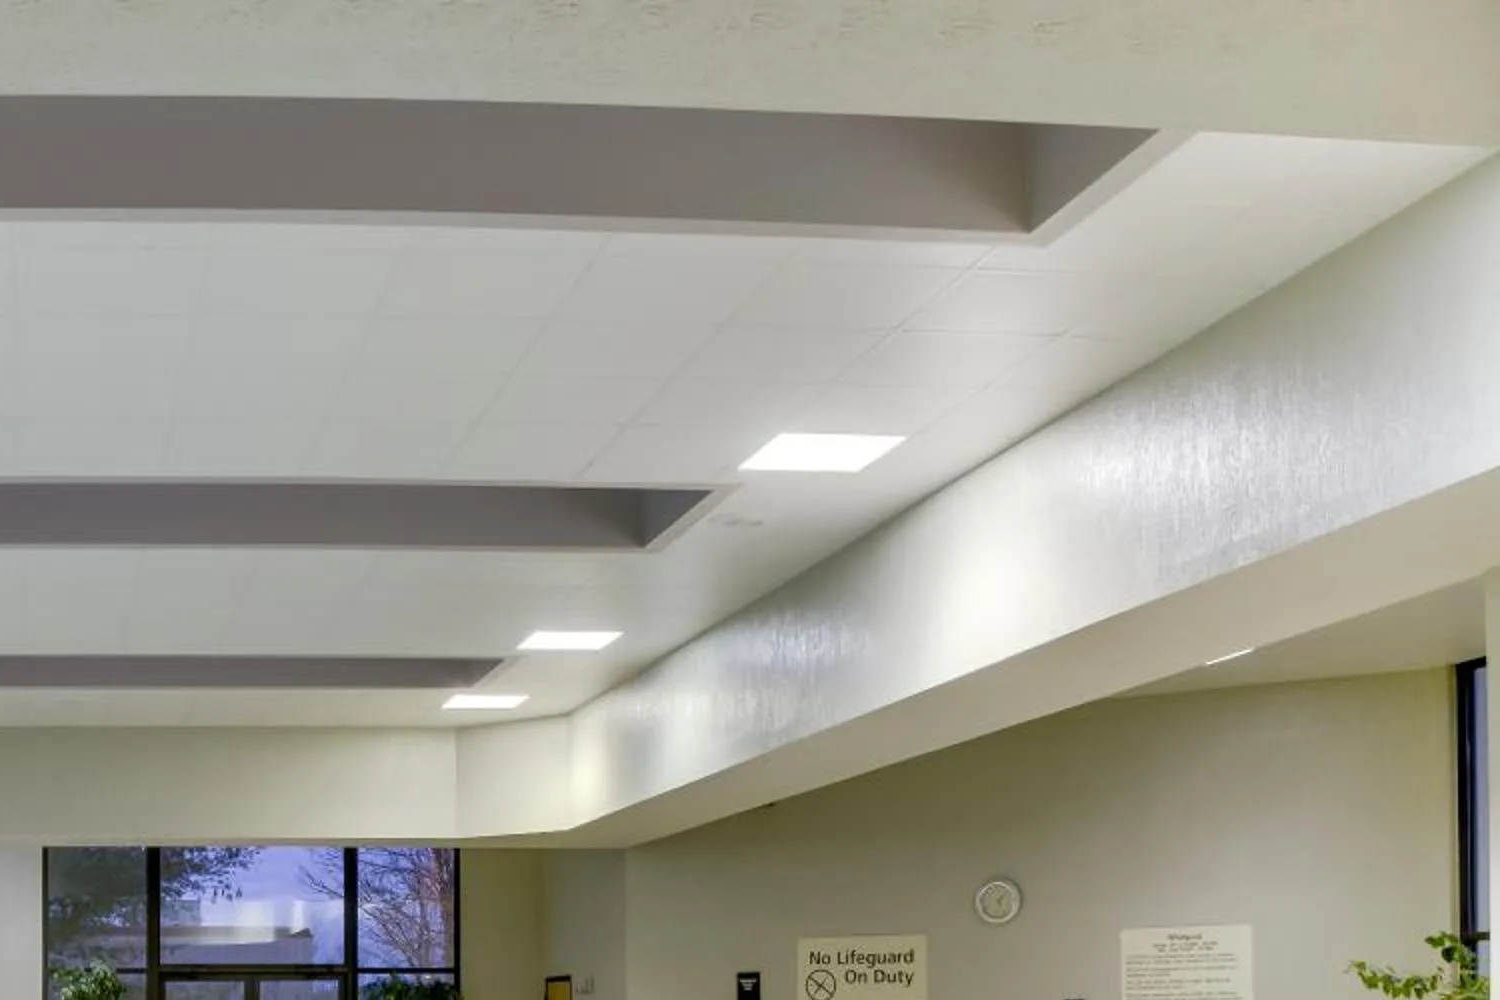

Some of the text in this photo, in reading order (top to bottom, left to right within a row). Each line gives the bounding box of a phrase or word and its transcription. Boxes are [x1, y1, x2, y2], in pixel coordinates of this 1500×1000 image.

[809, 949, 915, 968] No Lifeguard
[845, 969, 915, 988] On Duty
